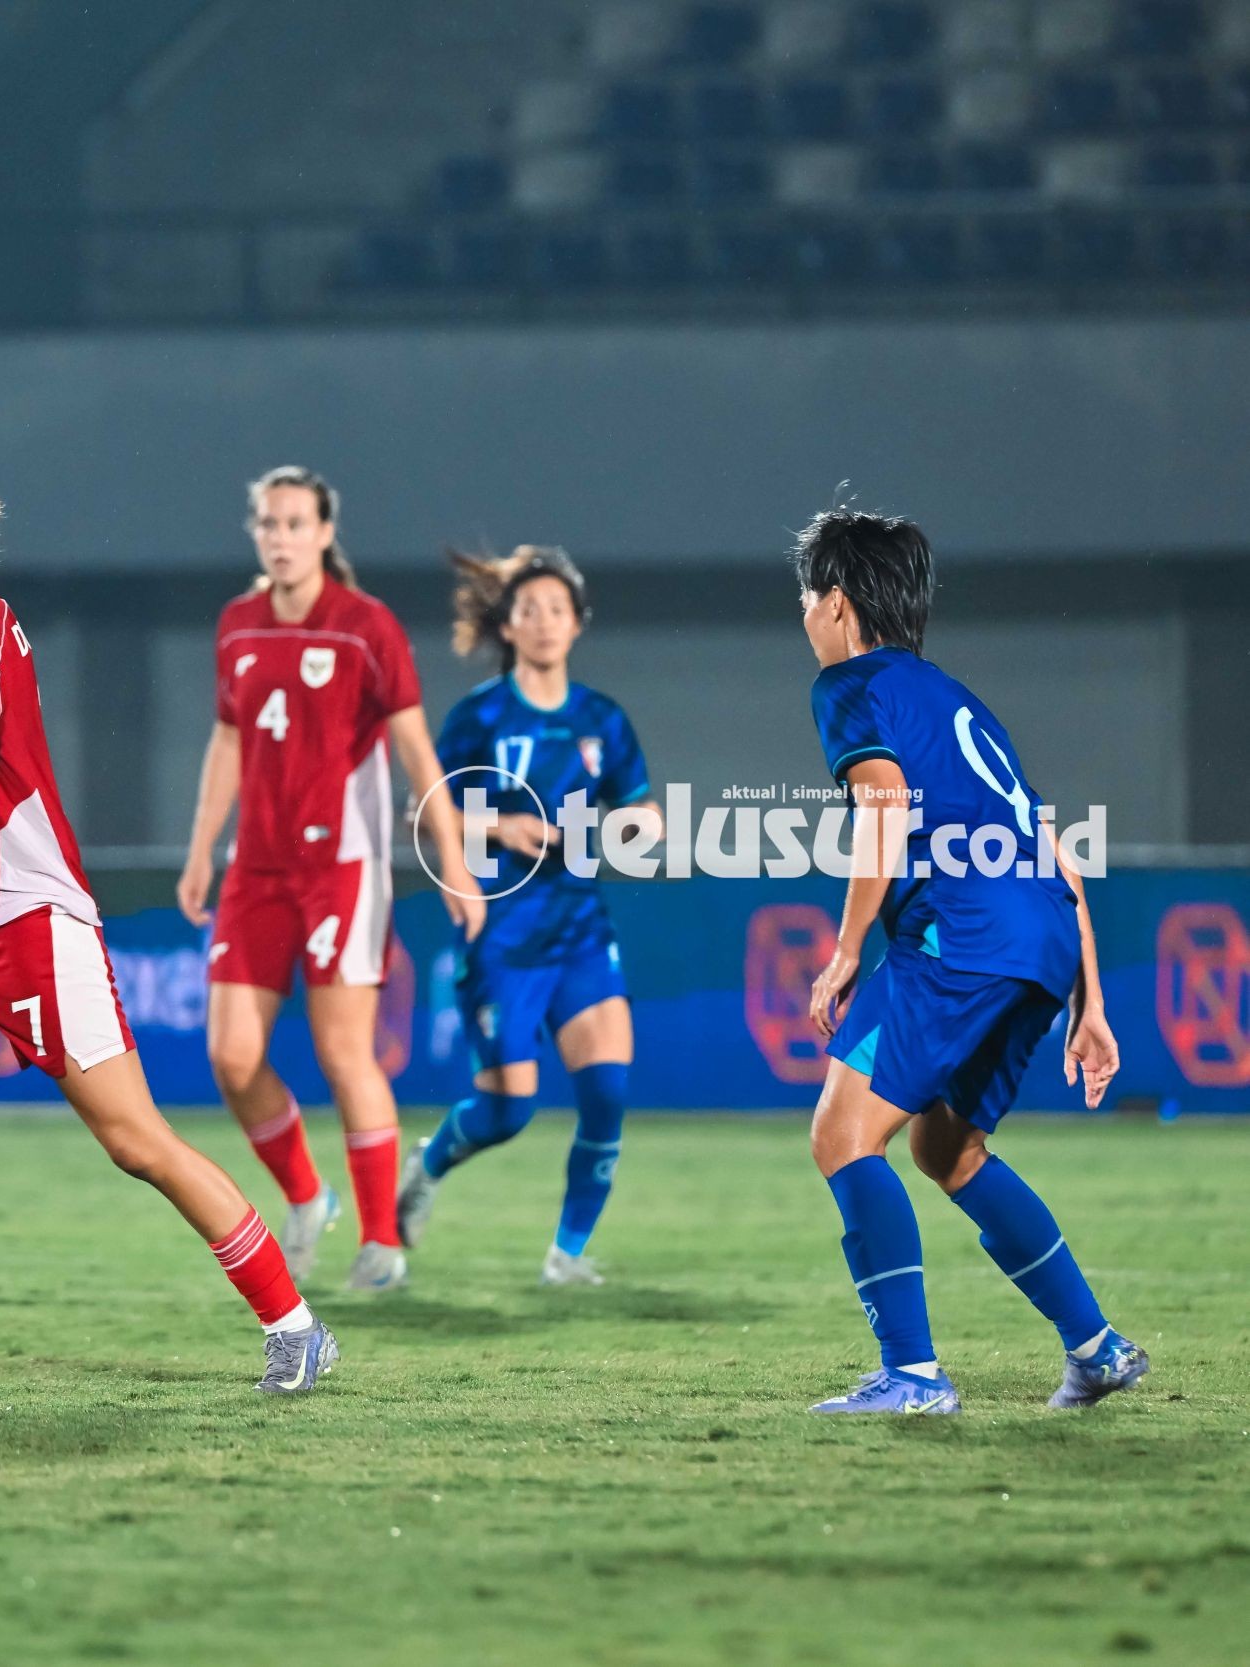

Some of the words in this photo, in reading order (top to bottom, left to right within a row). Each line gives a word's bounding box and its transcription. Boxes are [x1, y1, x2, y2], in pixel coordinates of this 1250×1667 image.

[255, 687, 291, 742] 4
[494, 734, 535, 792] 17
[953, 705, 1035, 838] 9
[305, 914, 341, 970] 4
[10, 994, 48, 1058] 7
